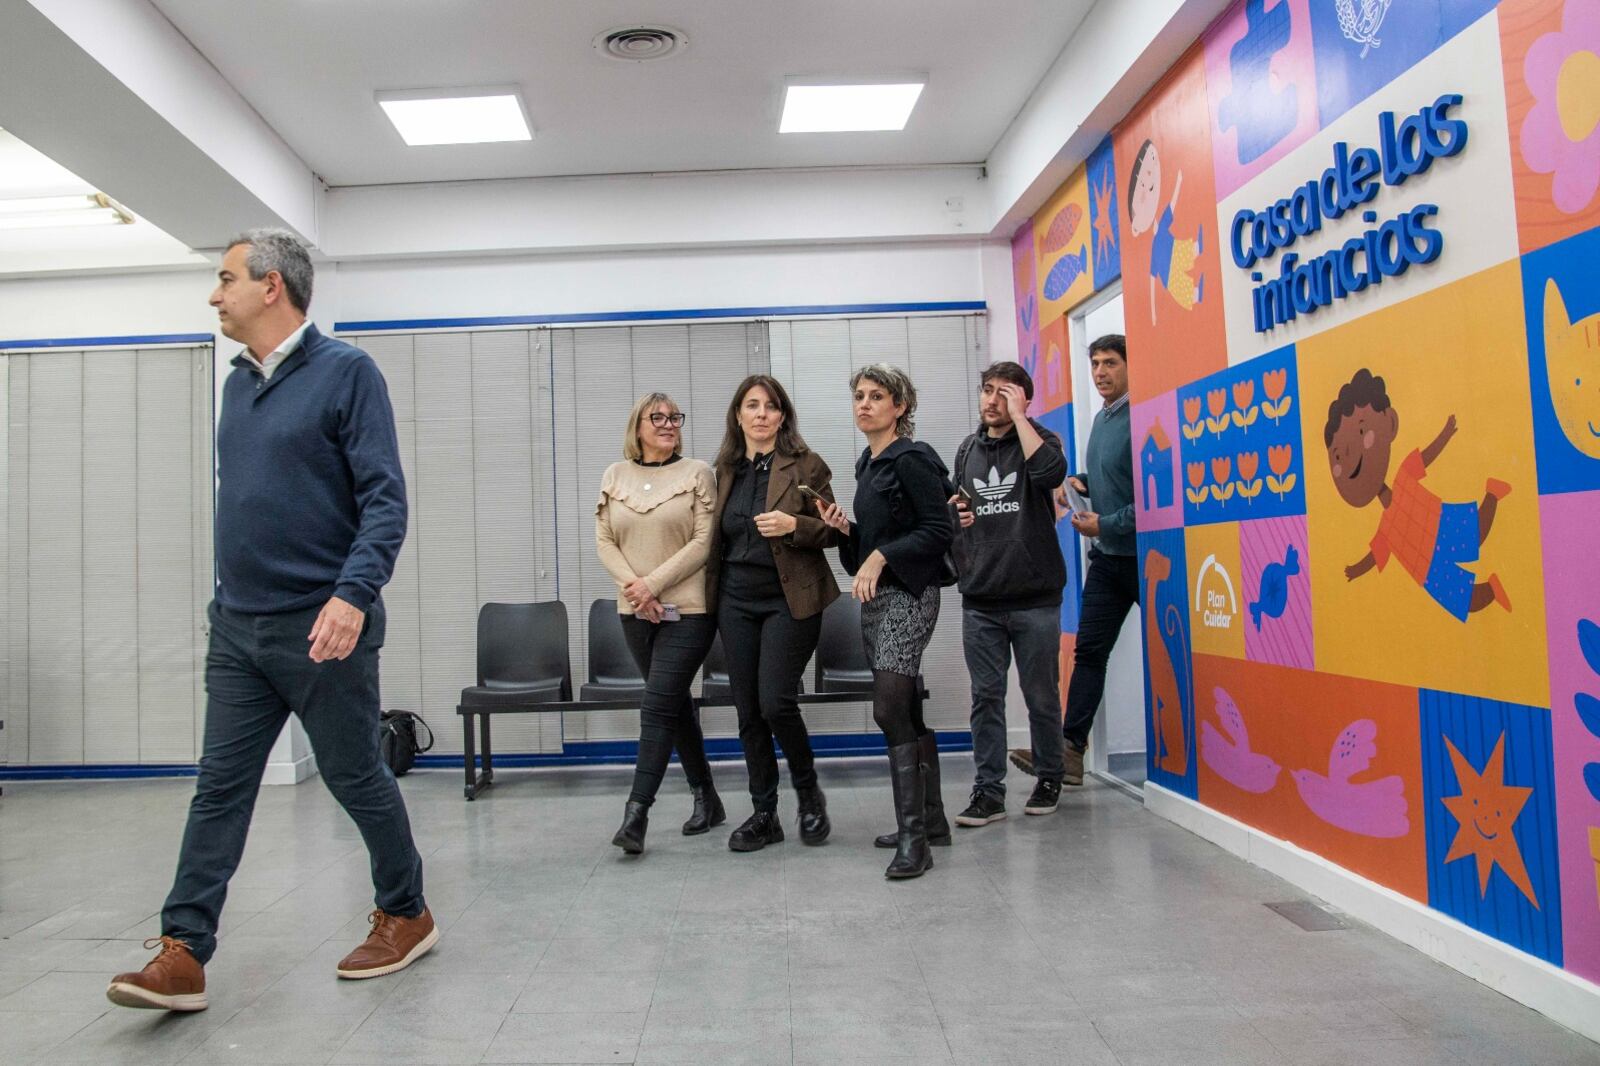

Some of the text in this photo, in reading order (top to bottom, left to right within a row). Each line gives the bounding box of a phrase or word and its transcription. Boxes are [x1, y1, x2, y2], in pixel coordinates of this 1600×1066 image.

[1231, 94, 1468, 269] Casa de las
[1251, 204, 1443, 333] infancias
[976, 501, 1020, 516] adidas
[1207, 590, 1225, 608] Plan
[1203, 609, 1232, 628] Cuidar
